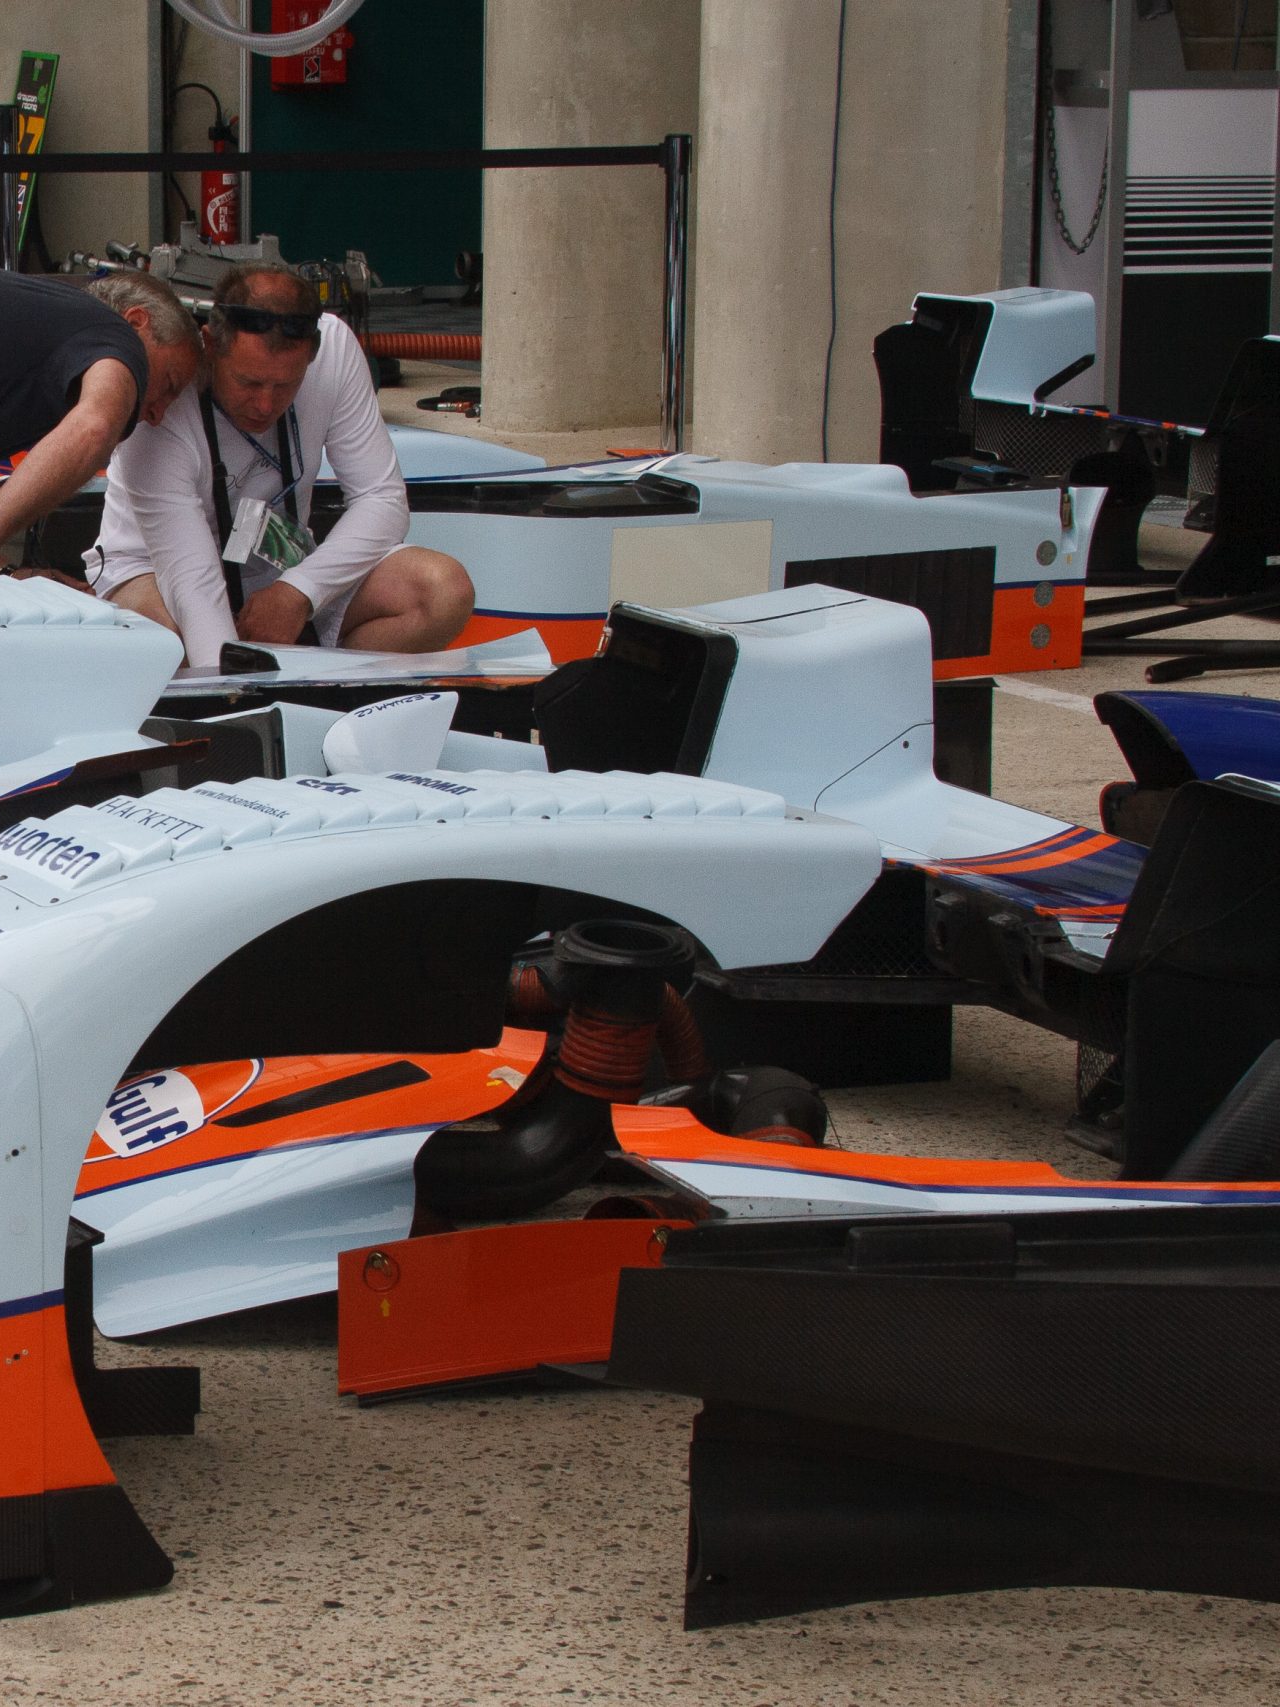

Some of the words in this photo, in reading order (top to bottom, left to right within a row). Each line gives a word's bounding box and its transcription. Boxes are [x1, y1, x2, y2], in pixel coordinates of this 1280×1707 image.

[385, 772, 478, 796] IMPROMAT
[97, 798, 204, 841] HACKETT
[105, 1075, 189, 1151] Gulf
